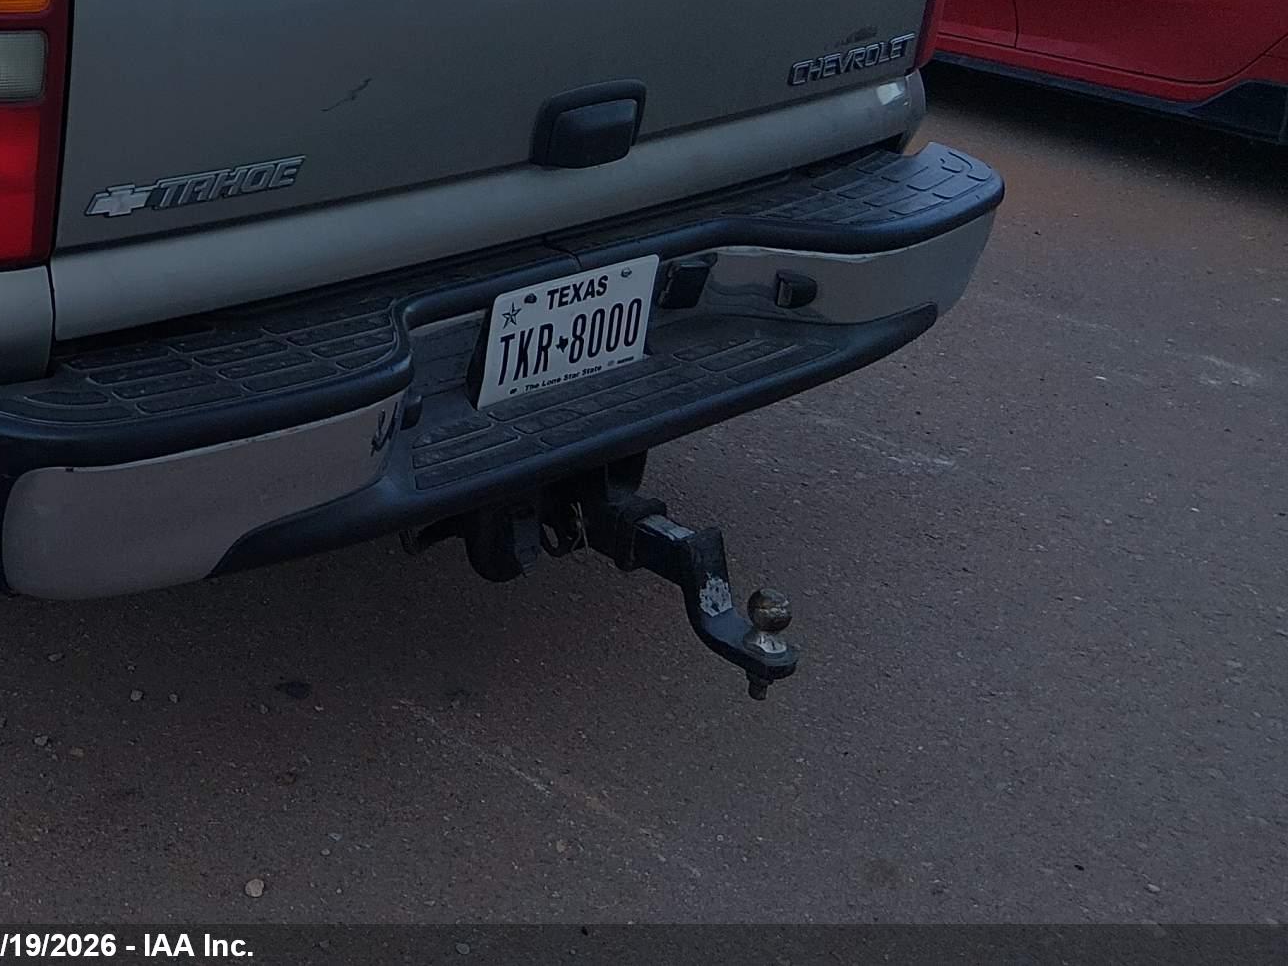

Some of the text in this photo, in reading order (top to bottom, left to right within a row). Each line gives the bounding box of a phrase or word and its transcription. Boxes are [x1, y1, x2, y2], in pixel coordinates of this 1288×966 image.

[788, 32, 915, 86] CHEVROLET
[158, 155, 307, 208] TAHOE
[547, 275, 609, 310] TEXAS
[498, 298, 642, 386] TKR 8000
